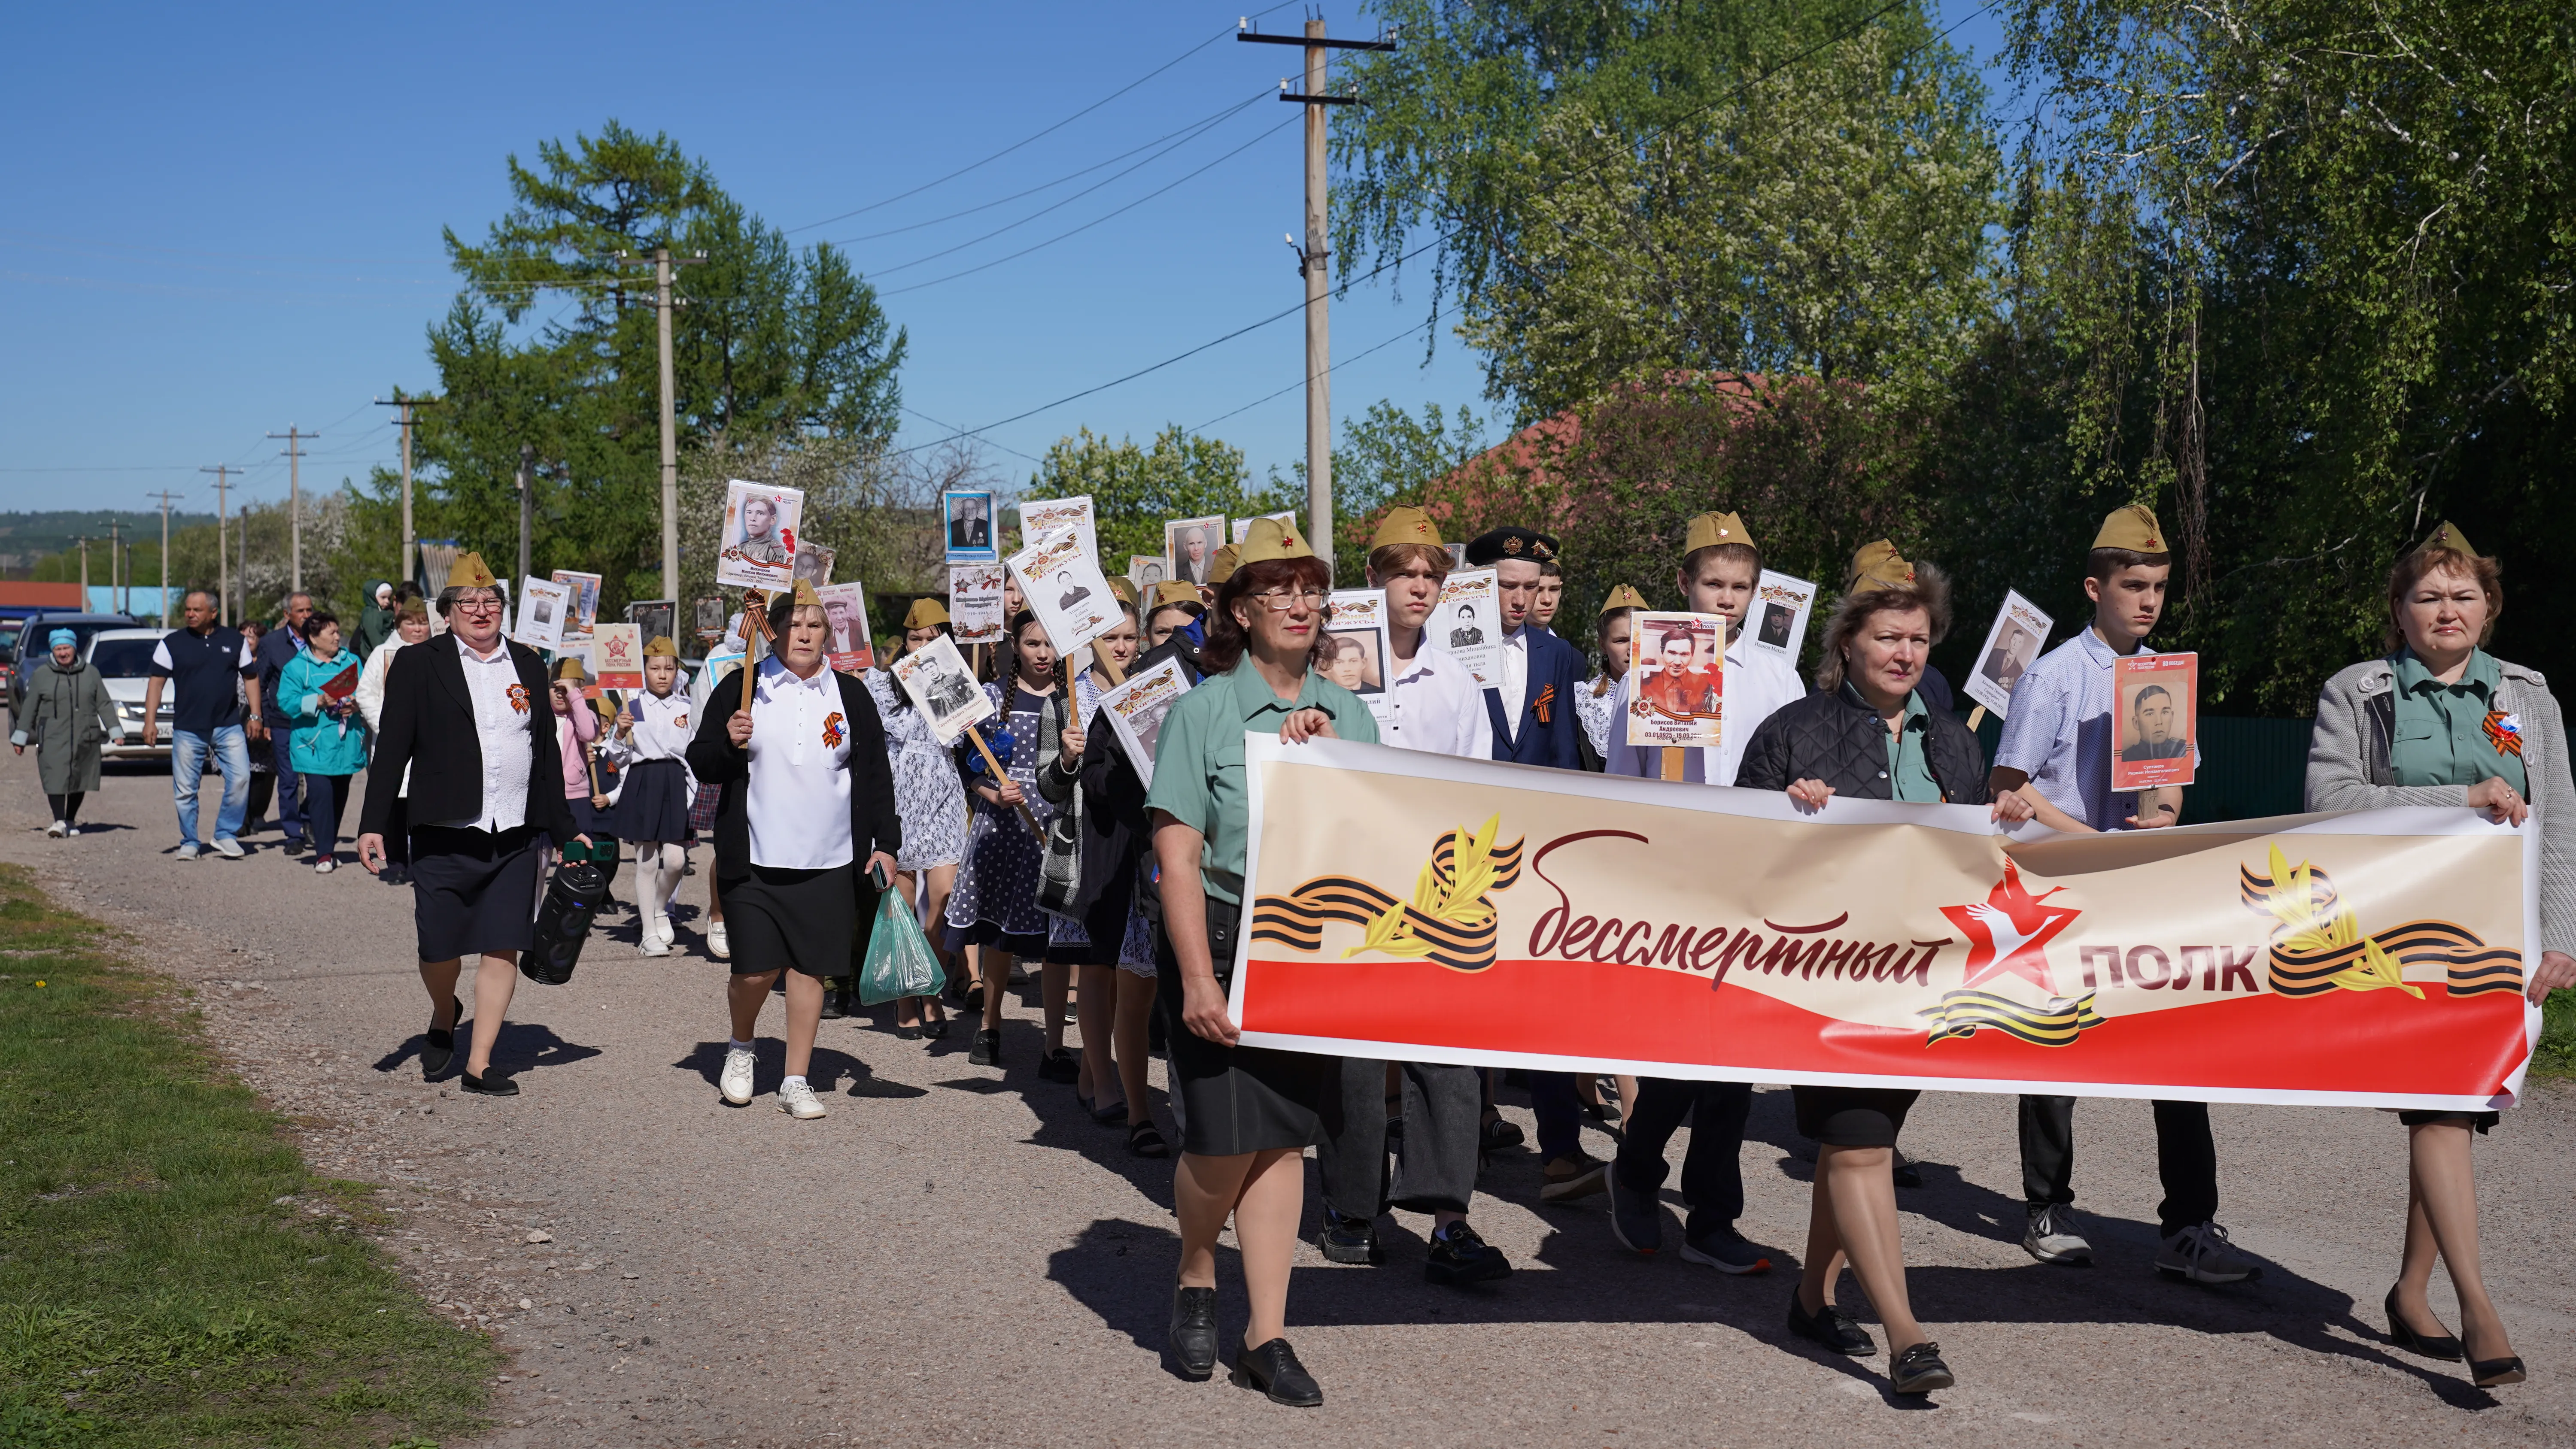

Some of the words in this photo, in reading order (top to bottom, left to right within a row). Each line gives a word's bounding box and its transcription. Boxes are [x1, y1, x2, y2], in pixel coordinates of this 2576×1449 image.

[1466, 644, 1496, 652] Минайбика
[1755, 641, 1770, 650] Иванов
[938, 718, 952, 728] Гареев
[951, 711, 964, 719] Хафиз
[964, 699, 983, 712] Закиевич
[2080, 944, 2260, 993] ПОЛК
